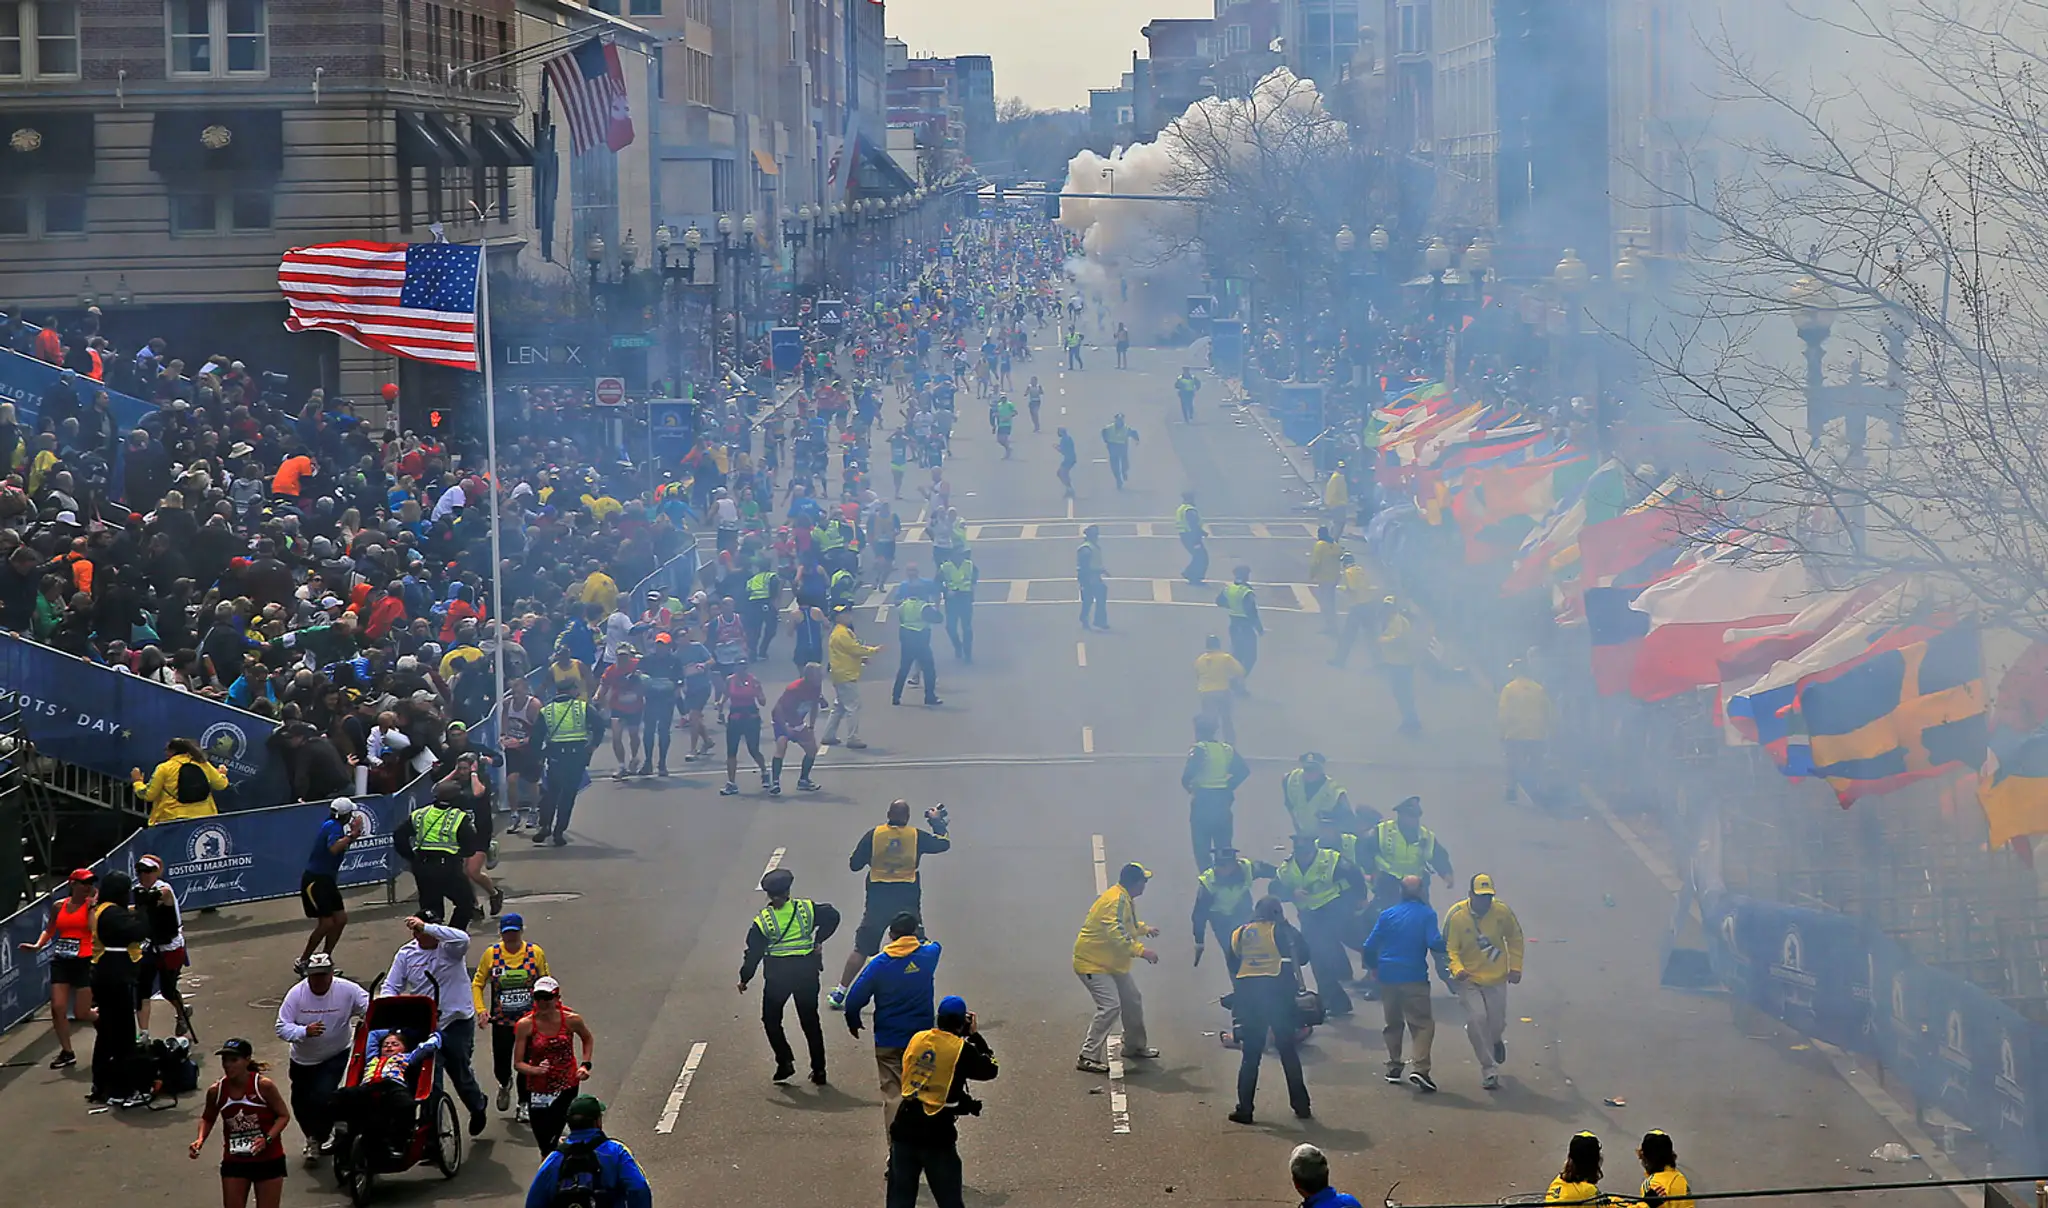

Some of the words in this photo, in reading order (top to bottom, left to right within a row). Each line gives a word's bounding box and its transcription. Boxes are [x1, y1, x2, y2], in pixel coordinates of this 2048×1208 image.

[77, 713, 120, 735] DAY
[168, 863, 202, 876] BOSTON
[203, 856, 252, 871] MARATHON
